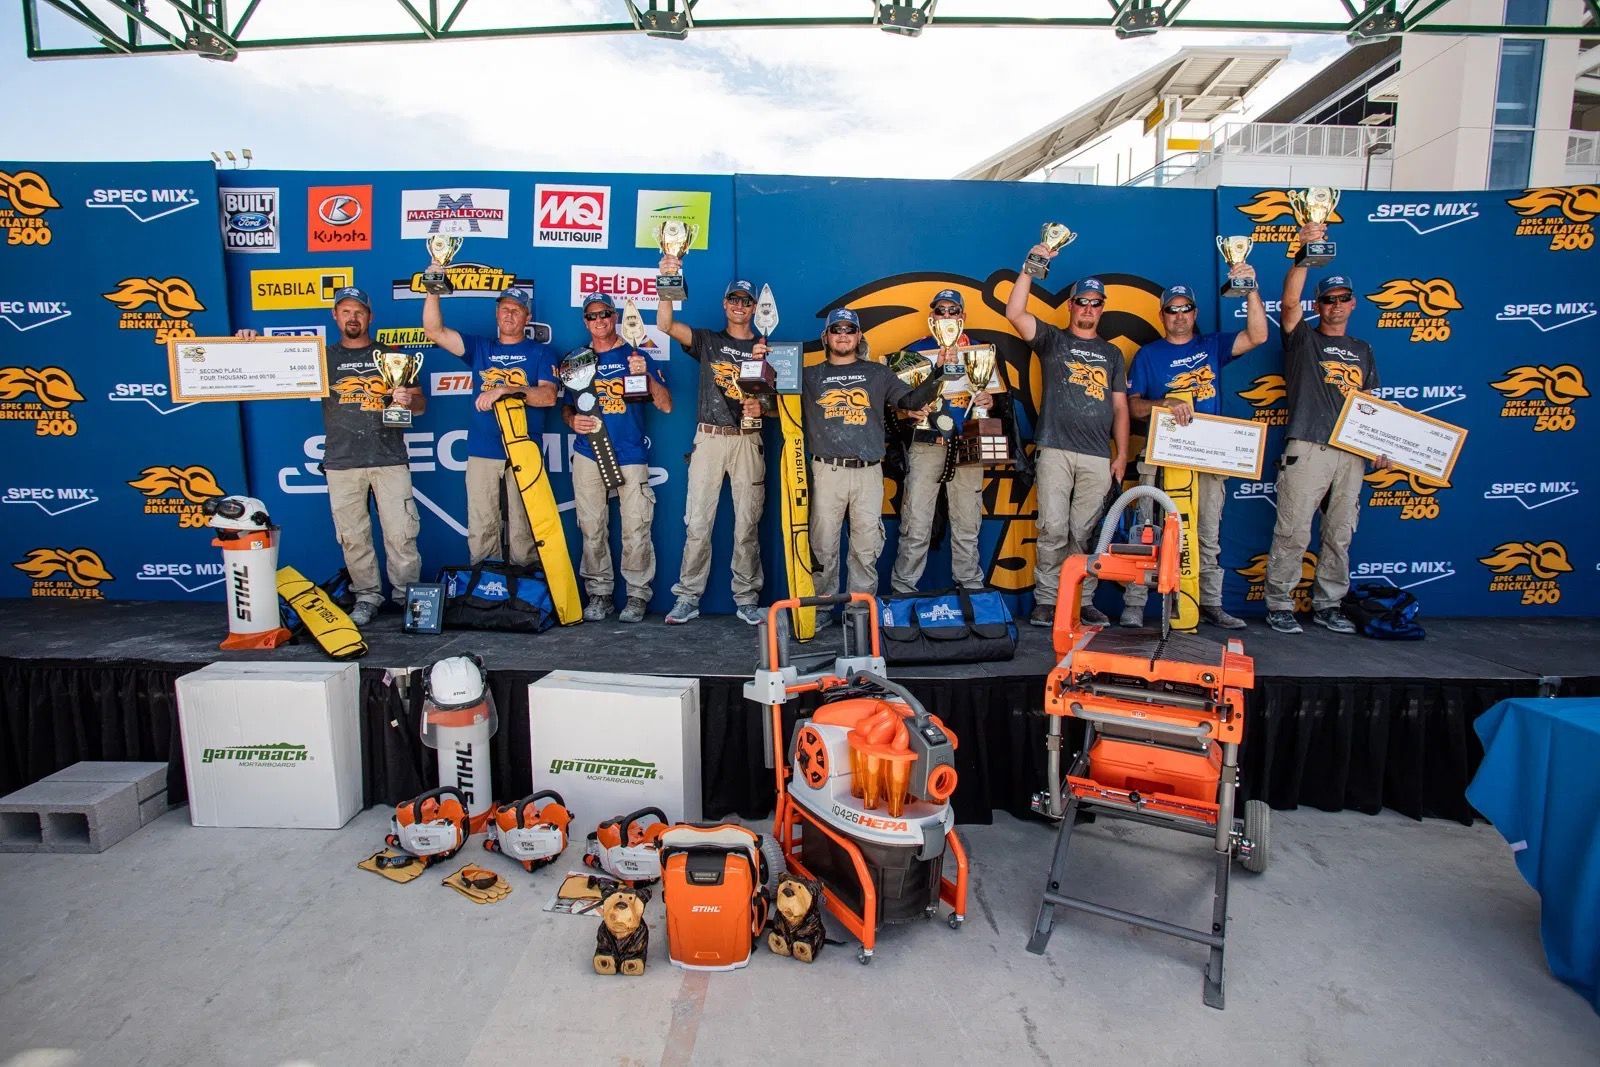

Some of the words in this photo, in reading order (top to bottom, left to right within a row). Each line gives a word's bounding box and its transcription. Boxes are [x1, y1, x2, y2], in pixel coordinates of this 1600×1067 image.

[93, 189, 147, 202] SPEC
[152, 189, 189, 202] MIX
[226, 195, 272, 212] BUILT
[408, 209, 502, 220] MARSHALLTOWN
[541, 195, 602, 227] MQ
[1377, 204, 1430, 217] SPEC
[1433, 203, 1471, 216] MIX
[238, 216, 261, 227] Ford
[1255, 225, 1277, 233] SPEC
[1278, 225, 1297, 233] MIX
[1516, 224, 1590, 236] BRICKLAYER
[8, 228, 52, 245] 500
[228, 231, 273, 246] TOUGH
[314, 230, 366, 243] Kubota
[539, 231, 602, 243] MULTIQUIP
[1252, 233, 1300, 242] BRICKLA
[1550, 233, 1594, 250] 500
[411, 273, 515, 291] QKRETE
[580, 273, 657, 295] BELDE
[258, 283, 315, 296] STABILA
[28, 302, 62, 314] MIX
[1504, 304, 1552, 316] SPEC
[1556, 303, 1589, 315] MIX
[120, 320, 189, 330] BRICKLAYER
[1378, 319, 1444, 328] BRICKLAYER
[1410, 327, 1450, 342] 500
[724, 346, 741, 356] SPEC
[115, 384, 167, 396] SPEC
[1371, 387, 1419, 398] SPEC
[1423, 386, 1457, 398] MIX
[0, 411, 70, 420] BRICKLAYER
[1501, 407, 1571, 417] BRICKLAYER
[36, 420, 77, 436] 500
[1533, 415, 1576, 432] 500
[794, 438, 804, 484] STABILA
[8, 488, 54, 500] SPEC
[58, 488, 88, 499] MIX
[1491, 482, 1536, 494] SPEC
[1540, 482, 1570, 493] MIX
[1369, 498, 1434, 506] BRICKLAYER
[144, 505, 203, 514] BRICKLAYE
[1400, 505, 1440, 519] 500
[142, 564, 192, 576] SPEC
[1358, 563, 1407, 574] SPEC
[1411, 562, 1446, 573] MIX
[32, 588, 100, 597] BRICKLAYER
[1490, 582, 1557, 592] BRICKLAYER
[236, 565, 252, 622] STIHL
[1521, 590, 1560, 605] 500
[316, 605, 338, 624] STABILA
[456, 743, 474, 805] STIHL
[586, 775, 644, 785] MORTARBOARDS
